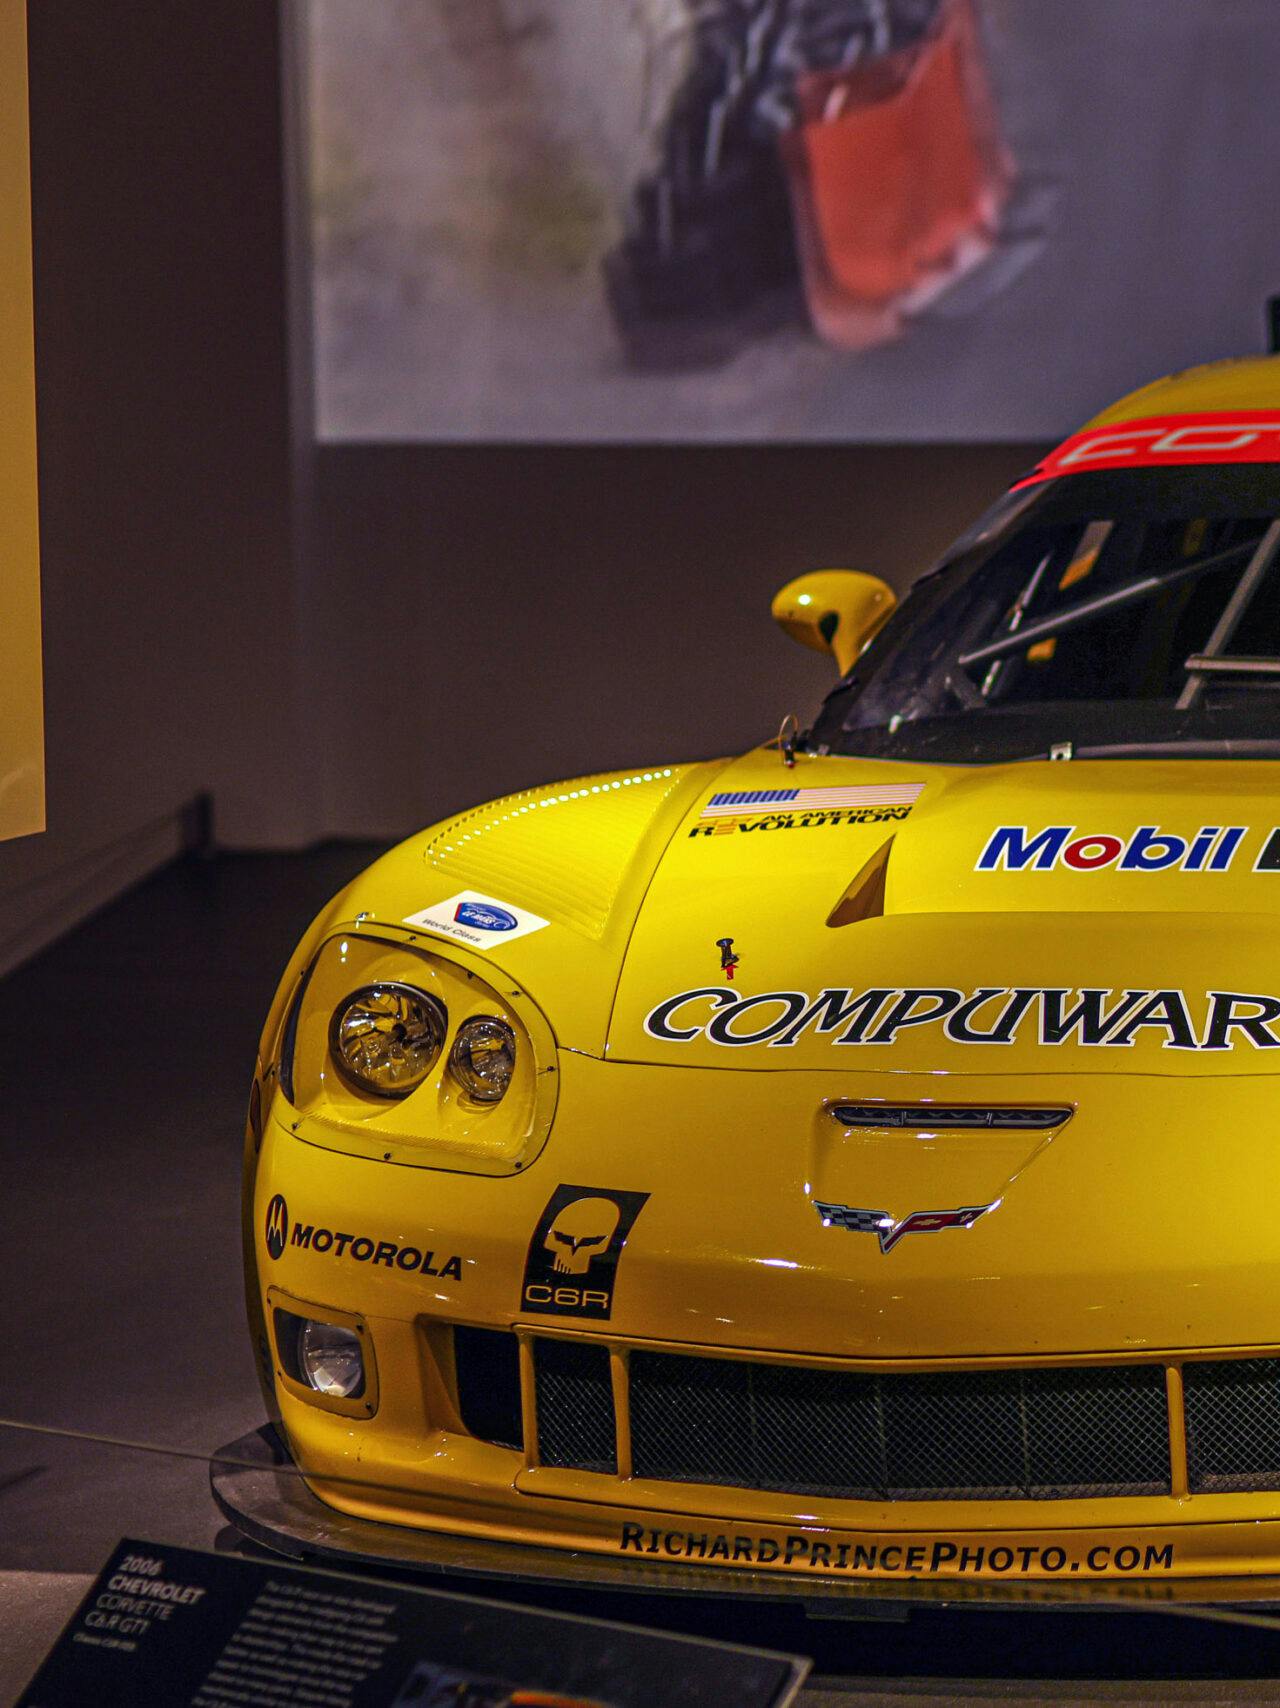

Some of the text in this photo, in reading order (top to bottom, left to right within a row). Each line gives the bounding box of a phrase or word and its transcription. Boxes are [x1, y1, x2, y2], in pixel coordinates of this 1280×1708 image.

[688, 810, 913, 838] REVOLUTION
[974, 825, 1250, 873] Mobil
[290, 1222, 463, 1281] MOTOROLA
[525, 1283, 610, 1310] C6R
[107, 1574, 207, 1605] CHEVROLET
[96, 1593, 175, 1620] CORVETTE
